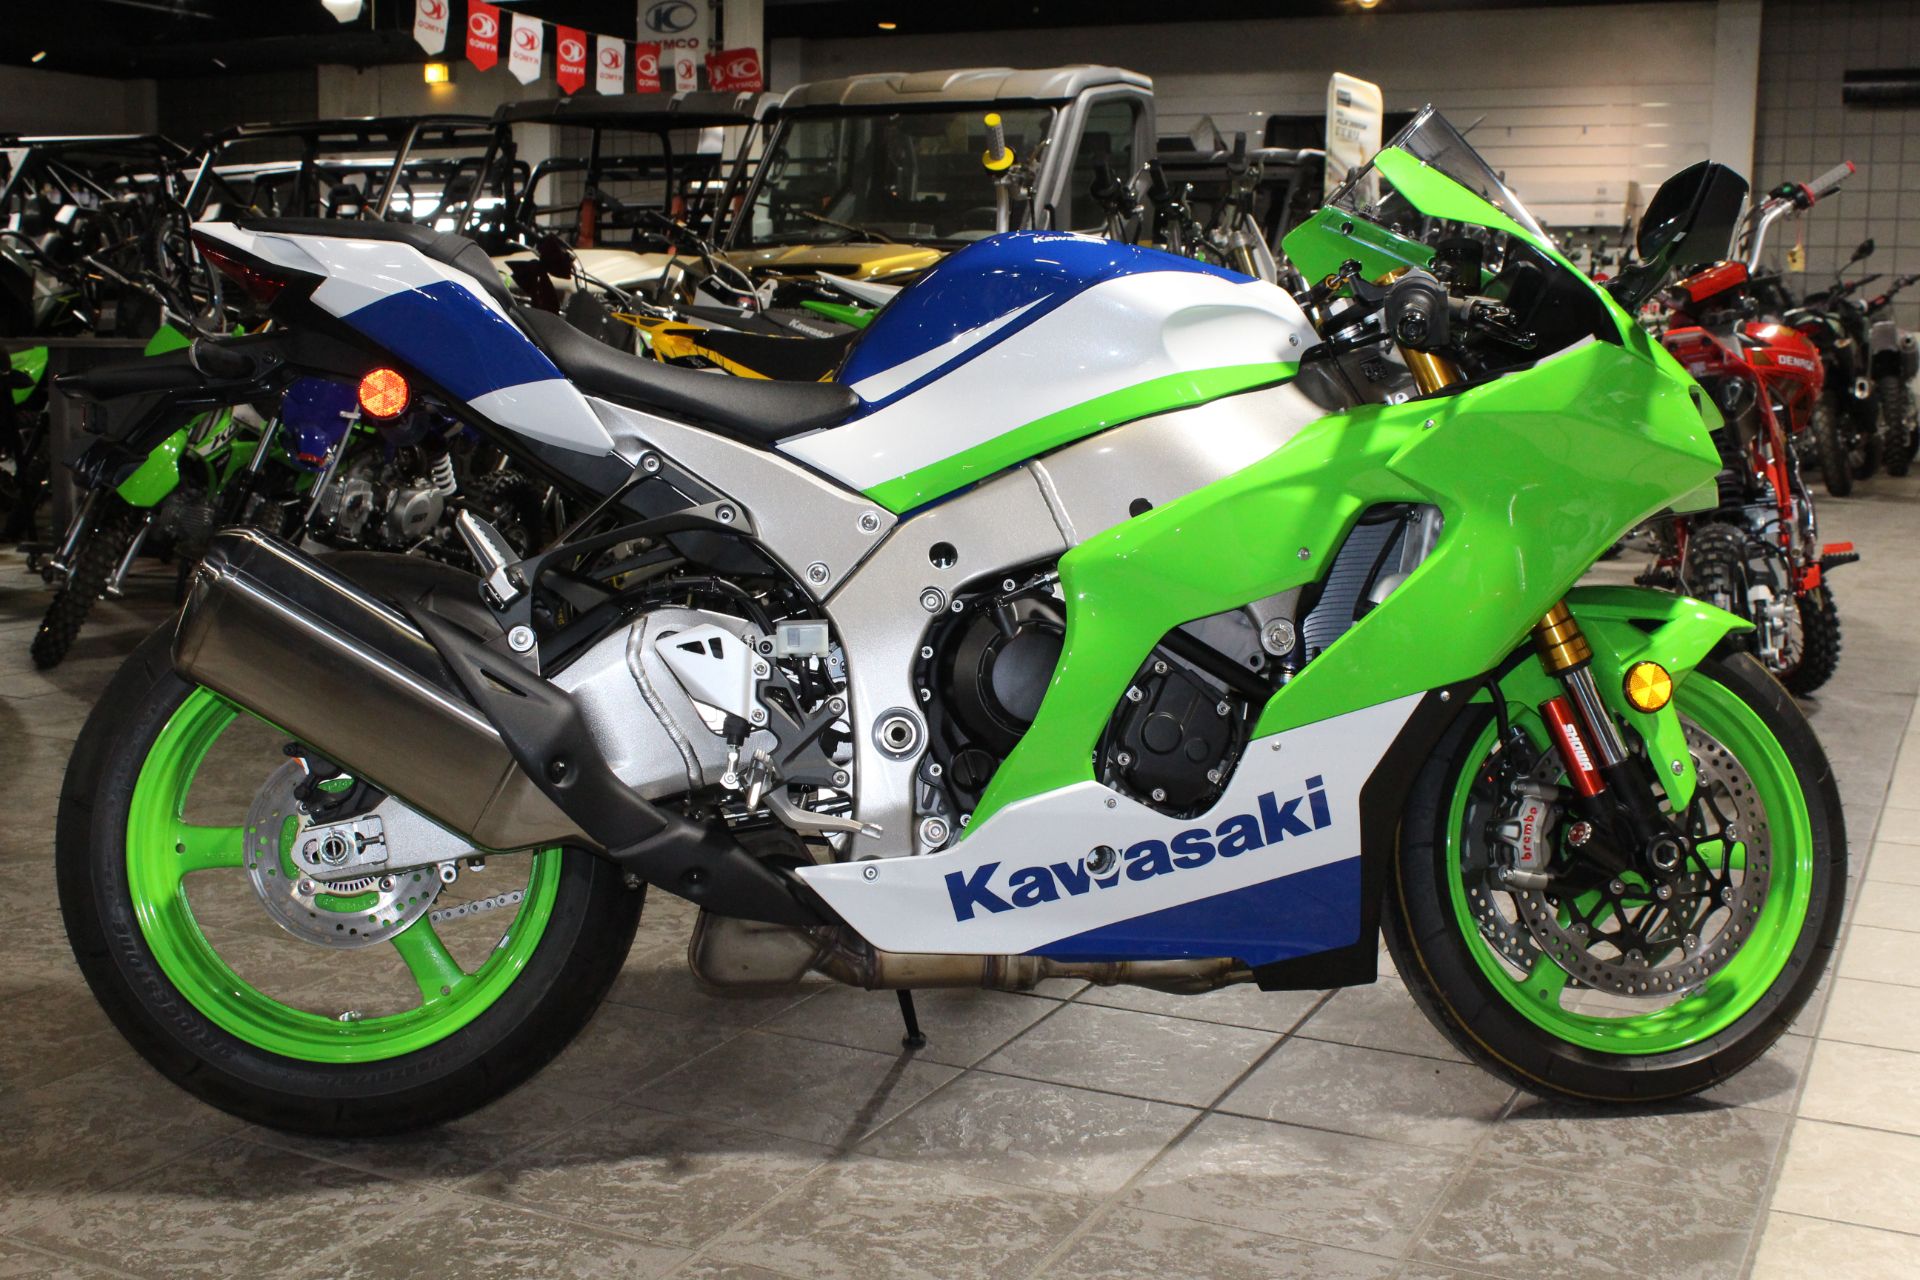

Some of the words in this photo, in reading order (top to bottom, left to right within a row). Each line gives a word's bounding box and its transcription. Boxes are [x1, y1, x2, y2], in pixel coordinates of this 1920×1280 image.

[1561, 723, 1594, 772] SHOWA
[945, 774, 1332, 922] Kawasaki
[1521, 806, 1538, 862] brembo
